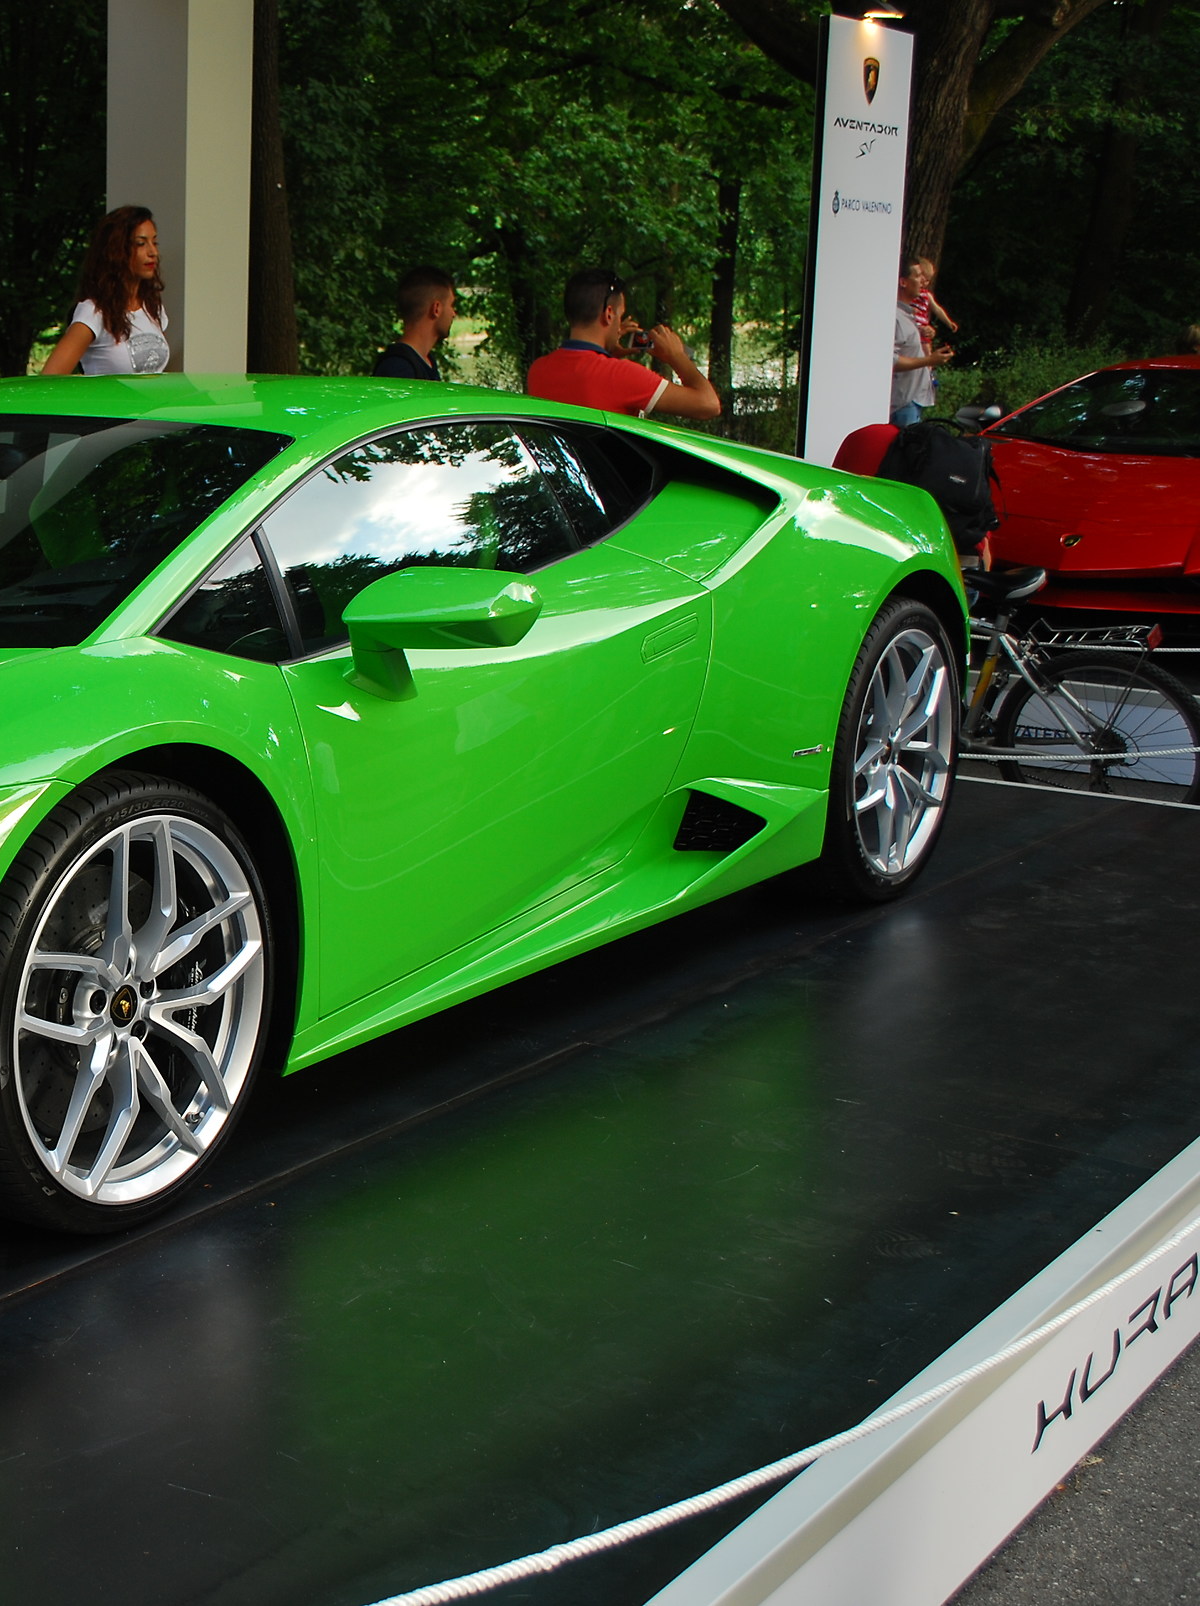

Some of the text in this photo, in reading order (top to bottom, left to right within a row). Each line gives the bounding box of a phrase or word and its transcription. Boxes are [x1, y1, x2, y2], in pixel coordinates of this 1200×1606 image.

[833, 117, 899, 137] AVENTADOR
[855, 138, 876, 159] SV
[841, 198, 892, 214] PARCO VALENTINO
[104, 801, 149, 828] 245/30
[151, 799, 185, 810] ZR20
[1031, 1252, 1198, 1454] HURA
